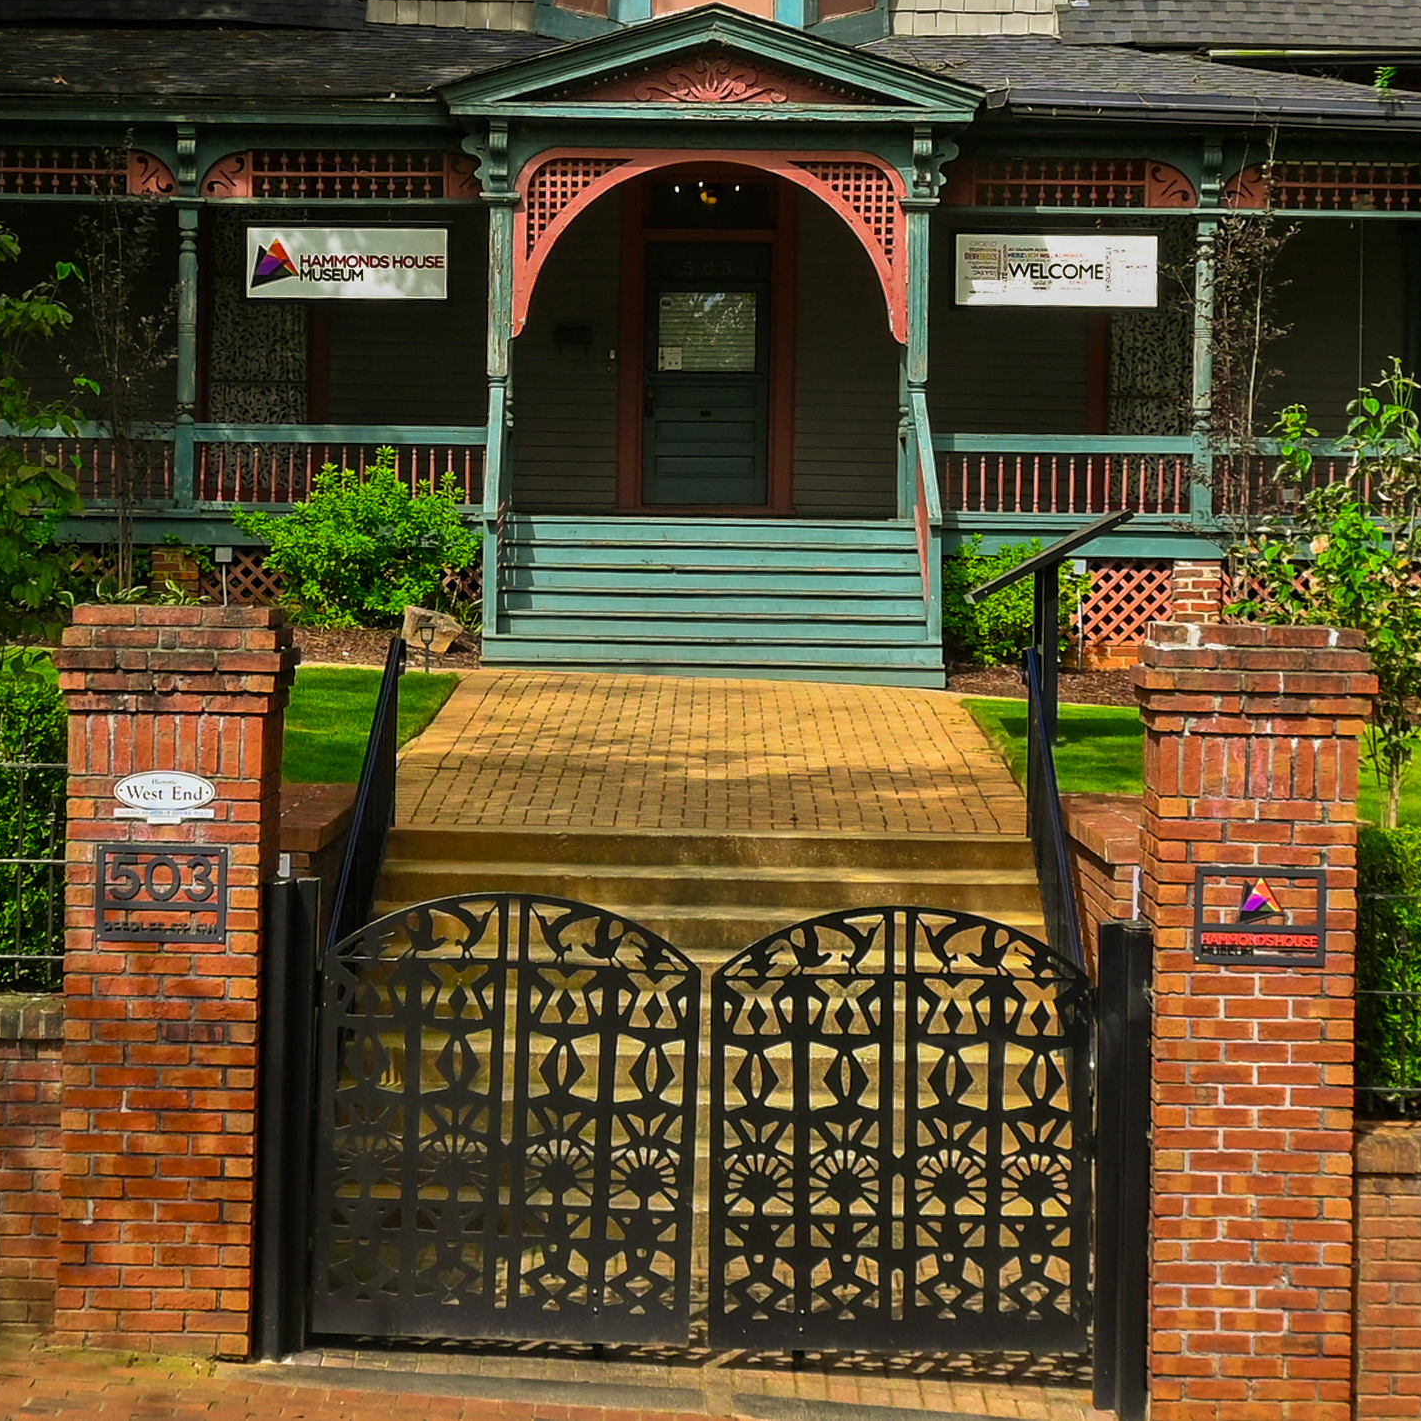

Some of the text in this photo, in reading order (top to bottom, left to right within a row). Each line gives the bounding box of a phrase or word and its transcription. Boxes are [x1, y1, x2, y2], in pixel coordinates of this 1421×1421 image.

[300, 254, 445, 269] HAMMONDS HOUSE
[300, 269, 364, 282] MUSEUM
[1009, 263, 1104, 280] WELCOME
[126, 785, 203, 801] West End
[109, 855, 214, 902] 503
[1201, 932, 1319, 948] HAMMONDS HOUSE
